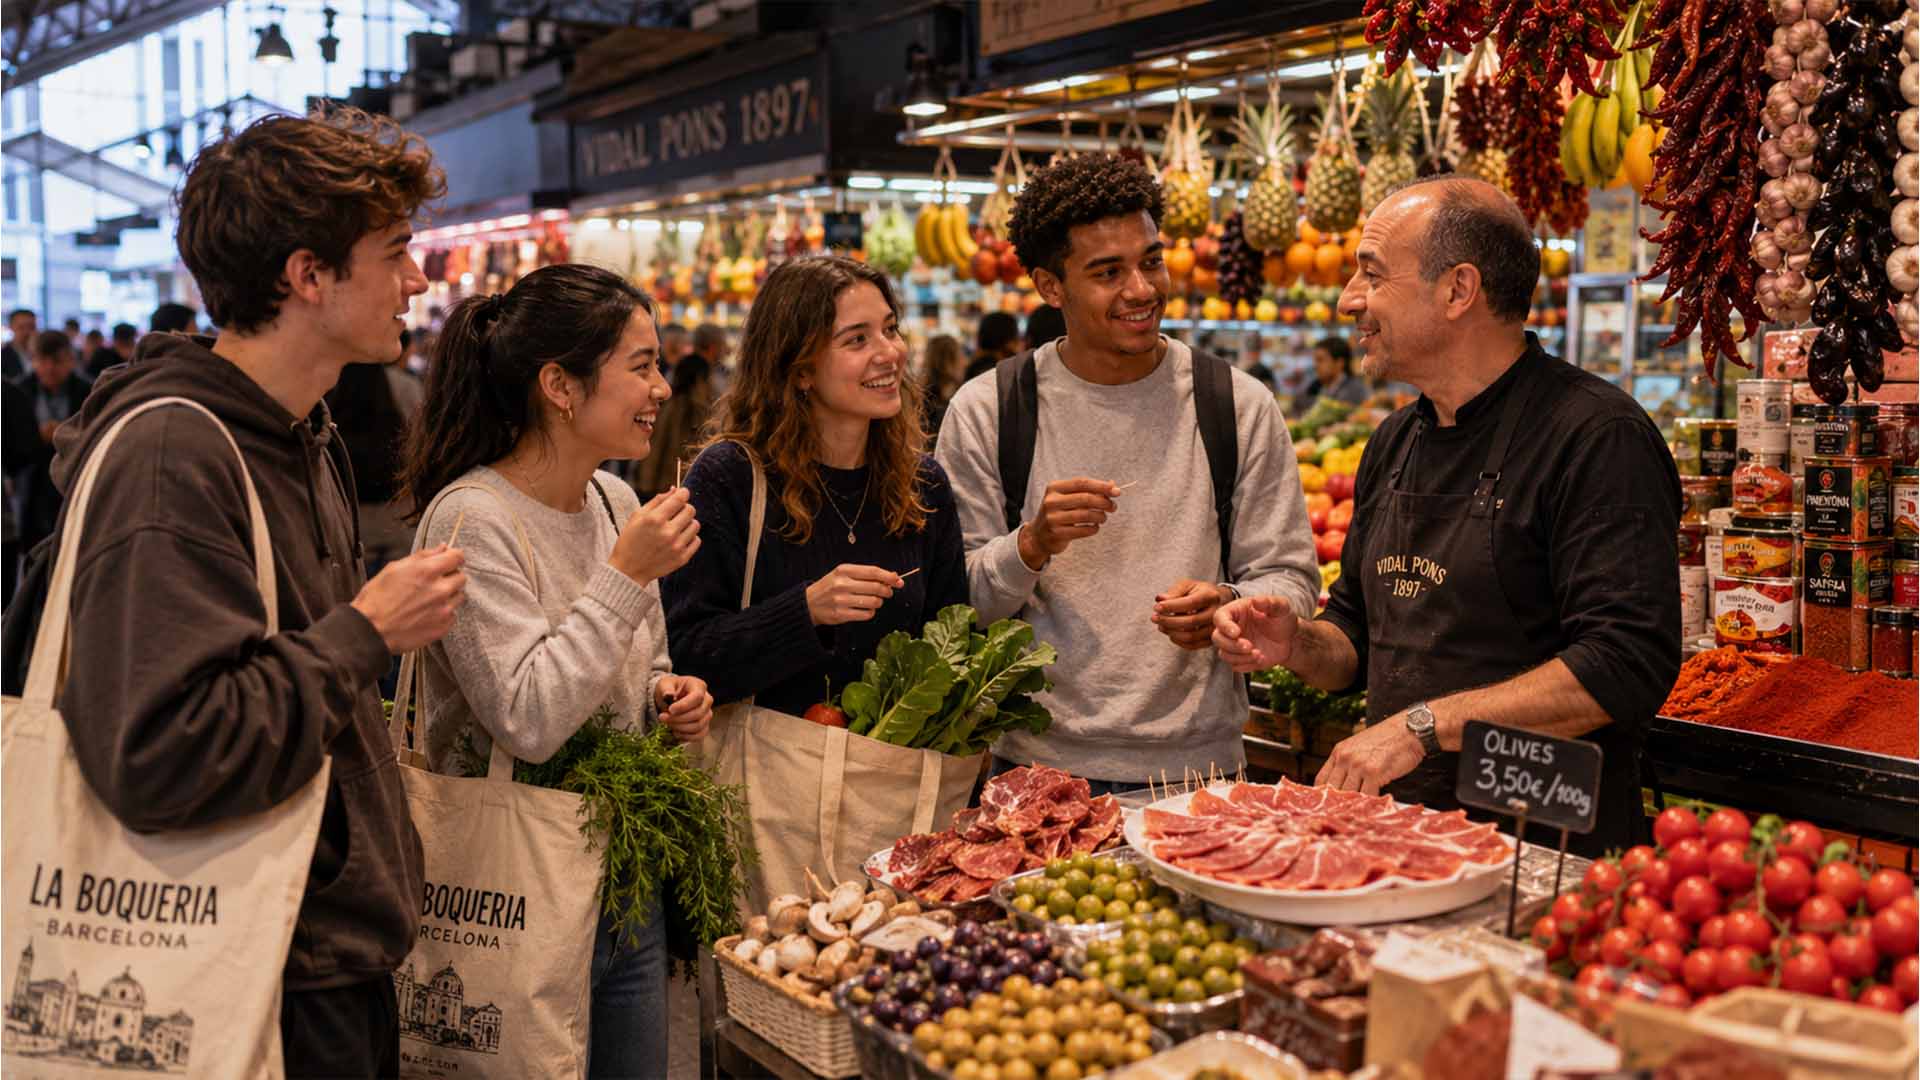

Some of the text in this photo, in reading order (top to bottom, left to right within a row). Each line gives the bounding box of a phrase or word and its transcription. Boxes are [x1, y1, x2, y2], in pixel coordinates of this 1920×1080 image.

[581, 77, 810, 176] VIDAL PONS 1897
[1376, 554, 1447, 585] VIDAL PONS
[1483, 729, 1555, 765] OLIVES
[30, 863, 219, 926] LA BOQUERIA
[422, 881, 526, 931] BOQUERIA
[46, 918, 188, 949] BARCELONA
[417, 925, 501, 950] RCELONA
